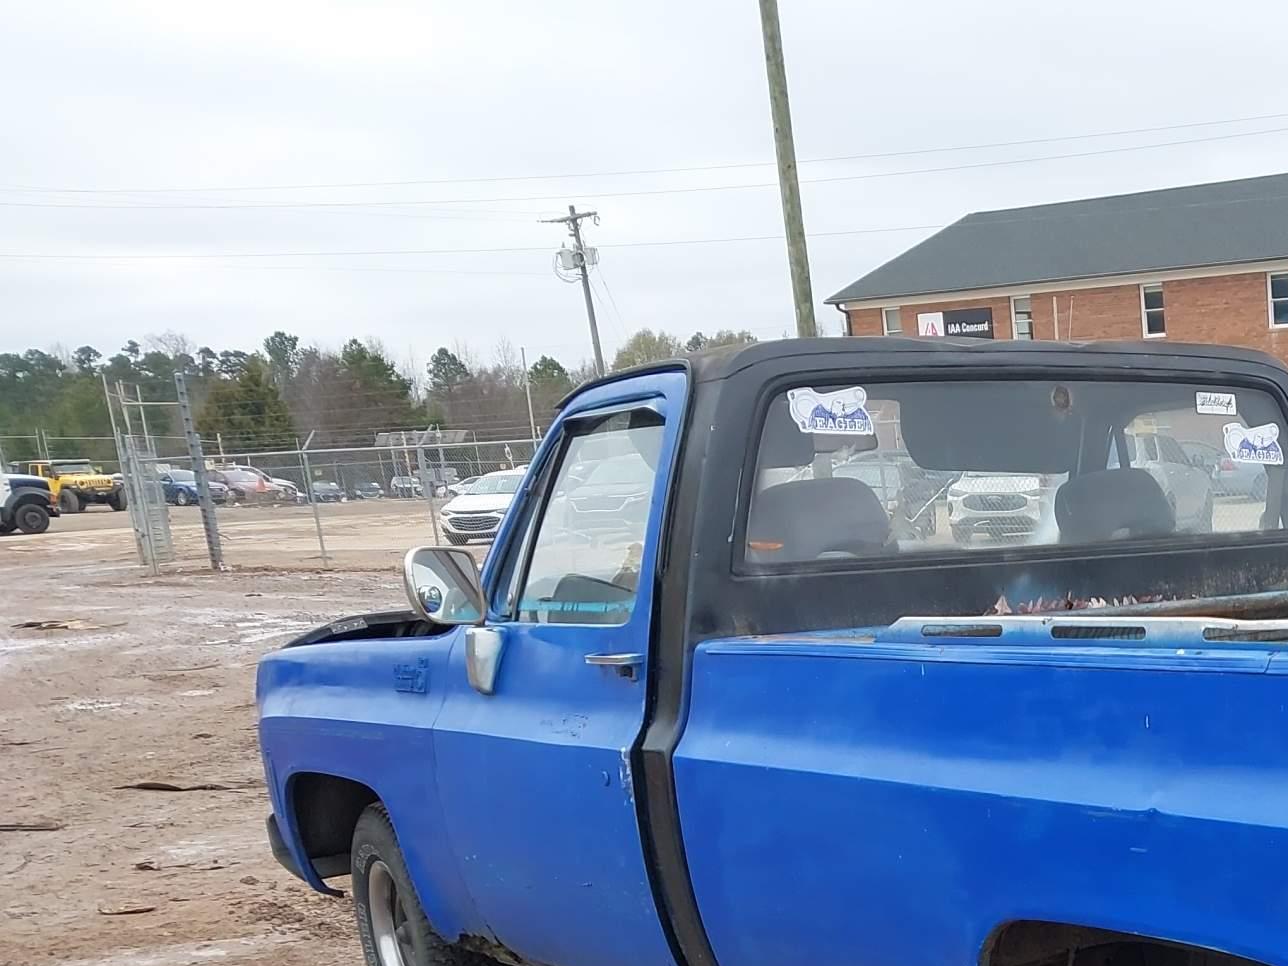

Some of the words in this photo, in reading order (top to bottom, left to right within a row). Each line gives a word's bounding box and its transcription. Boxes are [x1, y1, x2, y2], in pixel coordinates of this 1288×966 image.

[947, 322, 961, 334] IAA
[815, 417, 865, 431] EAGLE
[1240, 448, 1278, 461] EAGLE
